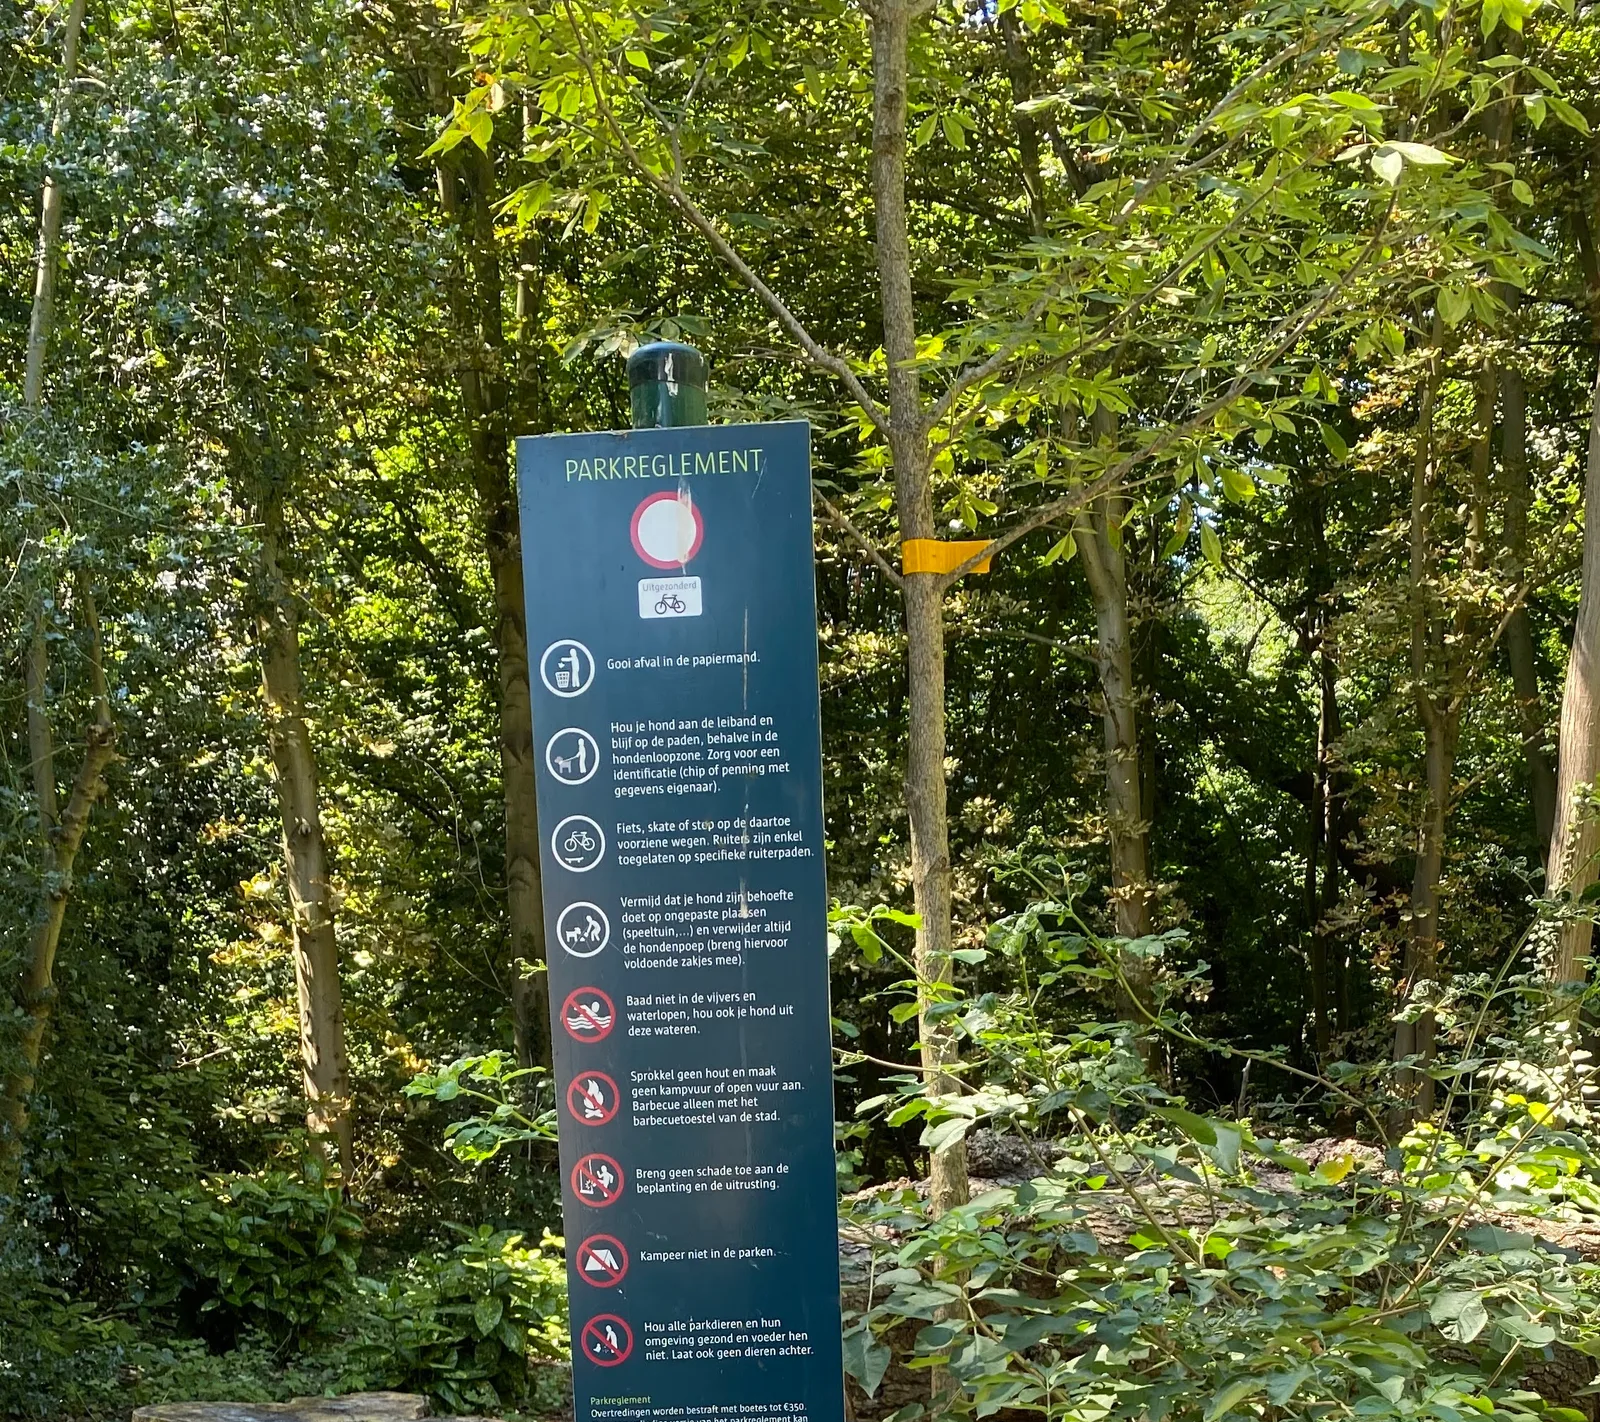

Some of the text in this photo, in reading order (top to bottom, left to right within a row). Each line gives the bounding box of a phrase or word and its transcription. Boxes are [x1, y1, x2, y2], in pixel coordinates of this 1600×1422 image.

[566, 449, 763, 482] PARKREGLEMENT
[643, 581, 696, 592] Uitgezonderd
[608, 651, 760, 669] Gooi afval in de papiermand.
[611, 715, 772, 733] Hou je hond aan de leiband en
[612, 730, 778, 750] blijf op de paden, behalve in de
[613, 748, 780, 764] hondenloopzone. Zorg voor een
[614, 762, 790, 780] identificatie (chip of penning met
[615, 782, 720, 798] gegevens eigenaar).
[627, 992, 755, 1006] Baad niet in de vijvers en
[627, 1005, 793, 1021] waterlopen, hou ook je hond uit
[628, 1025, 700, 1036] deze wateren.
[641, 1247, 776, 1262] Kampeer niet in de parken.
[645, 1322, 665, 1331] Hou
[668, 1321, 686, 1331] alle
[690, 1319, 742, 1332] parkdieren
[761, 1318, 780, 1327] hun
[645, 1335, 694, 1347] omgeving
[698, 1333, 733, 1346] gezond
[751, 1332, 786, 1342] voeder
[789, 1331, 807, 1341] hen
[646, 1345, 813, 1360] niet. Laat ook geen dieren achter.
[591, 1396, 650, 1406] Parkreglement
[591, 1408, 650, 1418] Overtredingen
[653, 1407, 684, 1415] worden
[686, 1405, 718, 1414] bestraft
[740, 1404, 767, 1412] boetes
[784, 1403, 806, 1412] €350.
